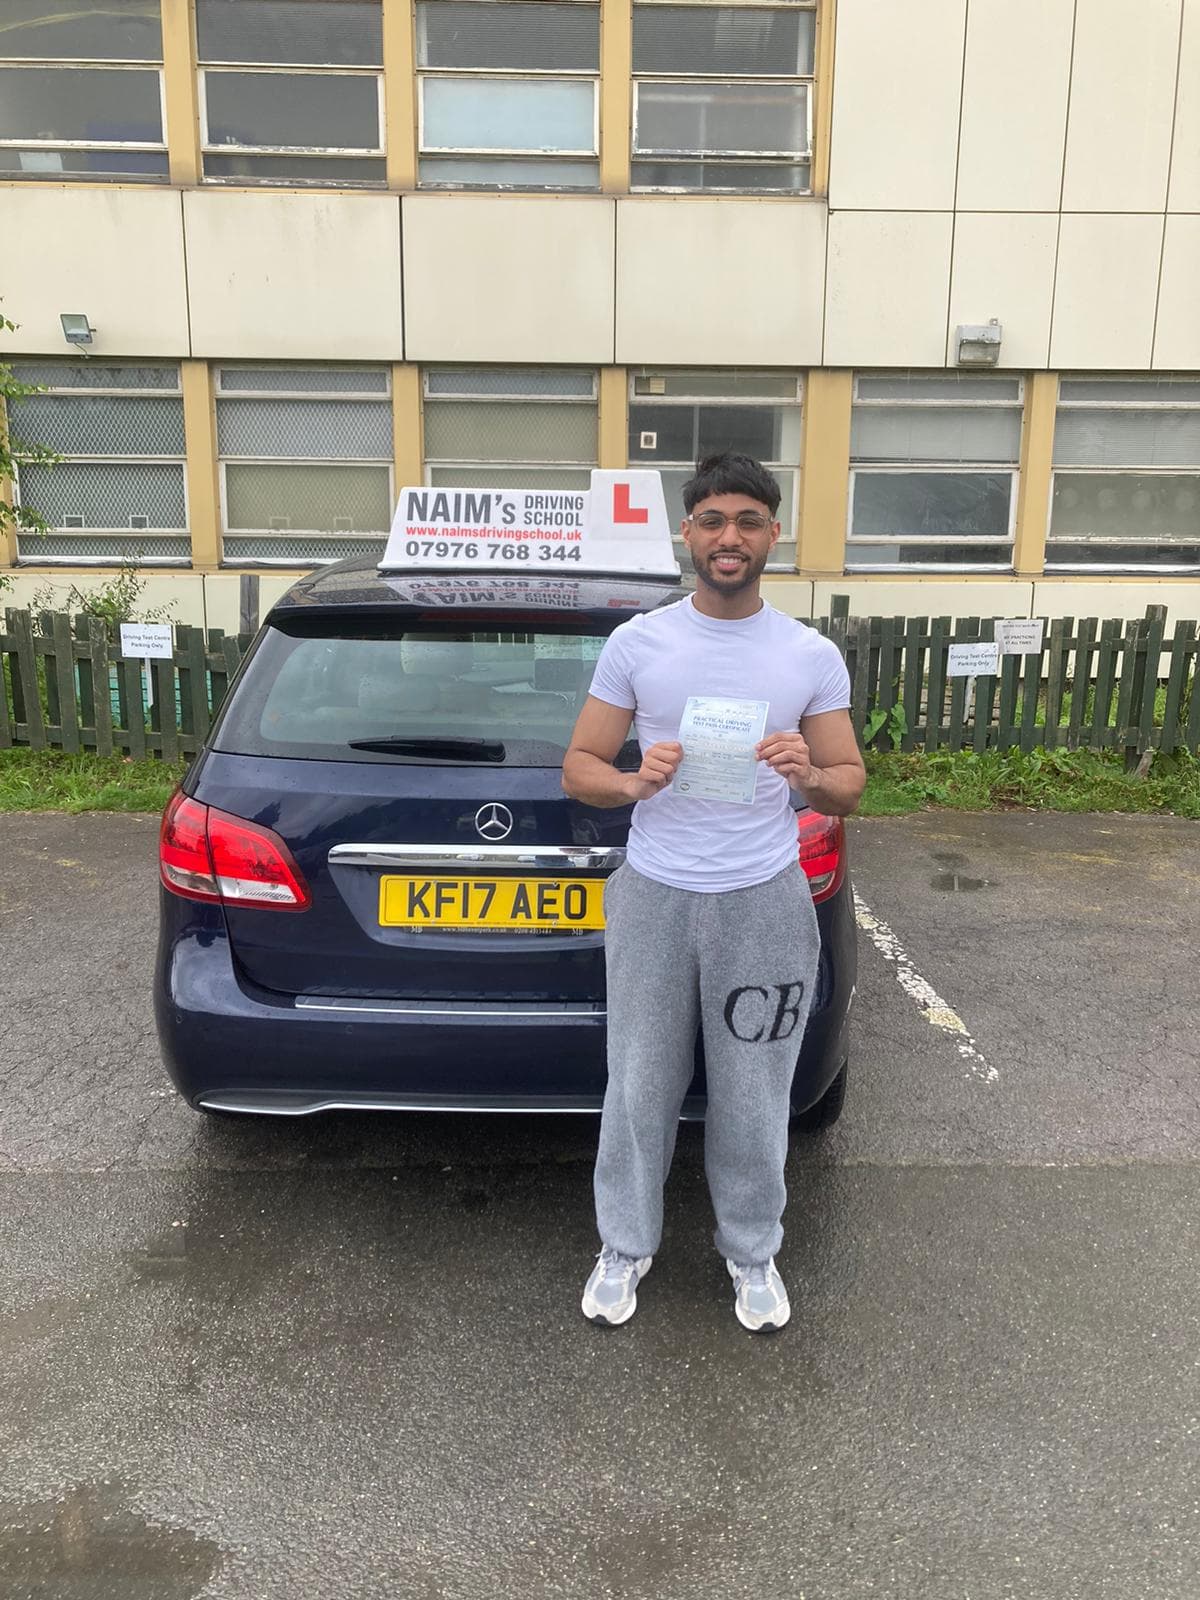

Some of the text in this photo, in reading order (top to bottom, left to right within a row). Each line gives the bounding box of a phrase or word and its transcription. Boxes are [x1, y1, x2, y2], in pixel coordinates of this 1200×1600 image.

[406, 492, 516, 525] NAIM's
[524, 495, 584, 510] DRIVING
[613, 483, 648, 523] L
[523, 511, 583, 527] SCHOOL
[405, 525, 582, 541] www.naimsdrivingschool.uk
[405, 540, 582, 562] 07976 768 344
[693, 715, 752, 728] PRACTICAL DRIVING
[407, 881, 588, 921] KF17 AEO
[724, 981, 804, 1043] CB
